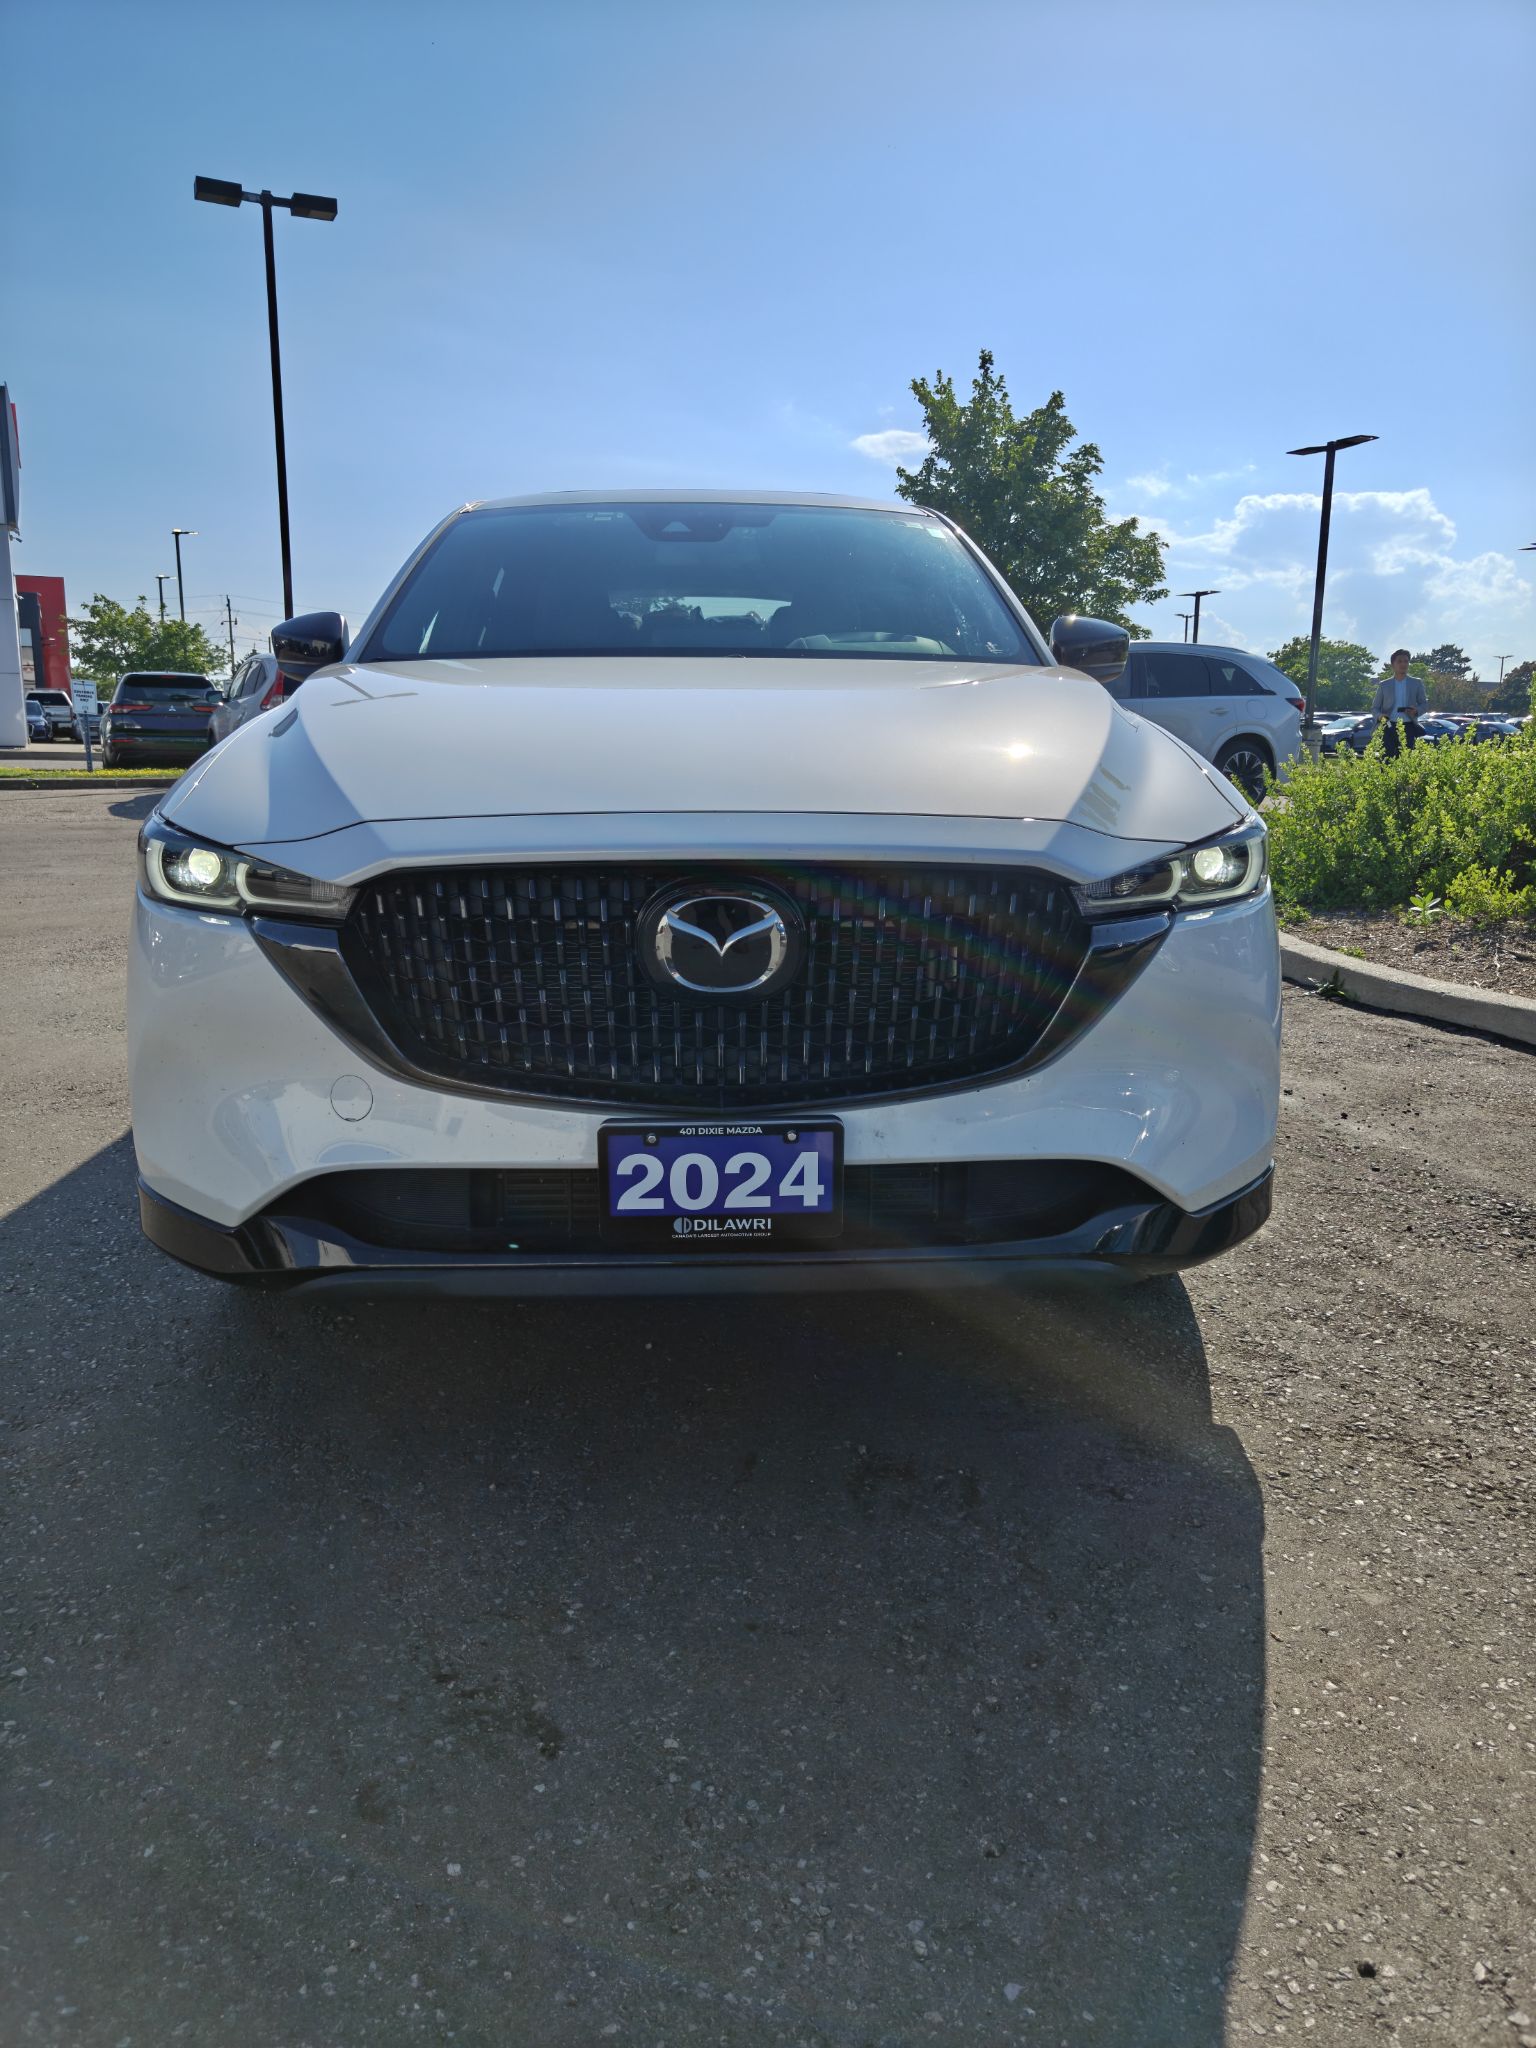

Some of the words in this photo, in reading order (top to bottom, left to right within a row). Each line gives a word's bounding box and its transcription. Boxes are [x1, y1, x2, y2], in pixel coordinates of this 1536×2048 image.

[698, 1127, 724, 1135] DIXIE
[726, 1126, 763, 1134] MAZDA
[616, 1152, 825, 1210] 2024
[694, 1218, 772, 1231] DILAWRI
